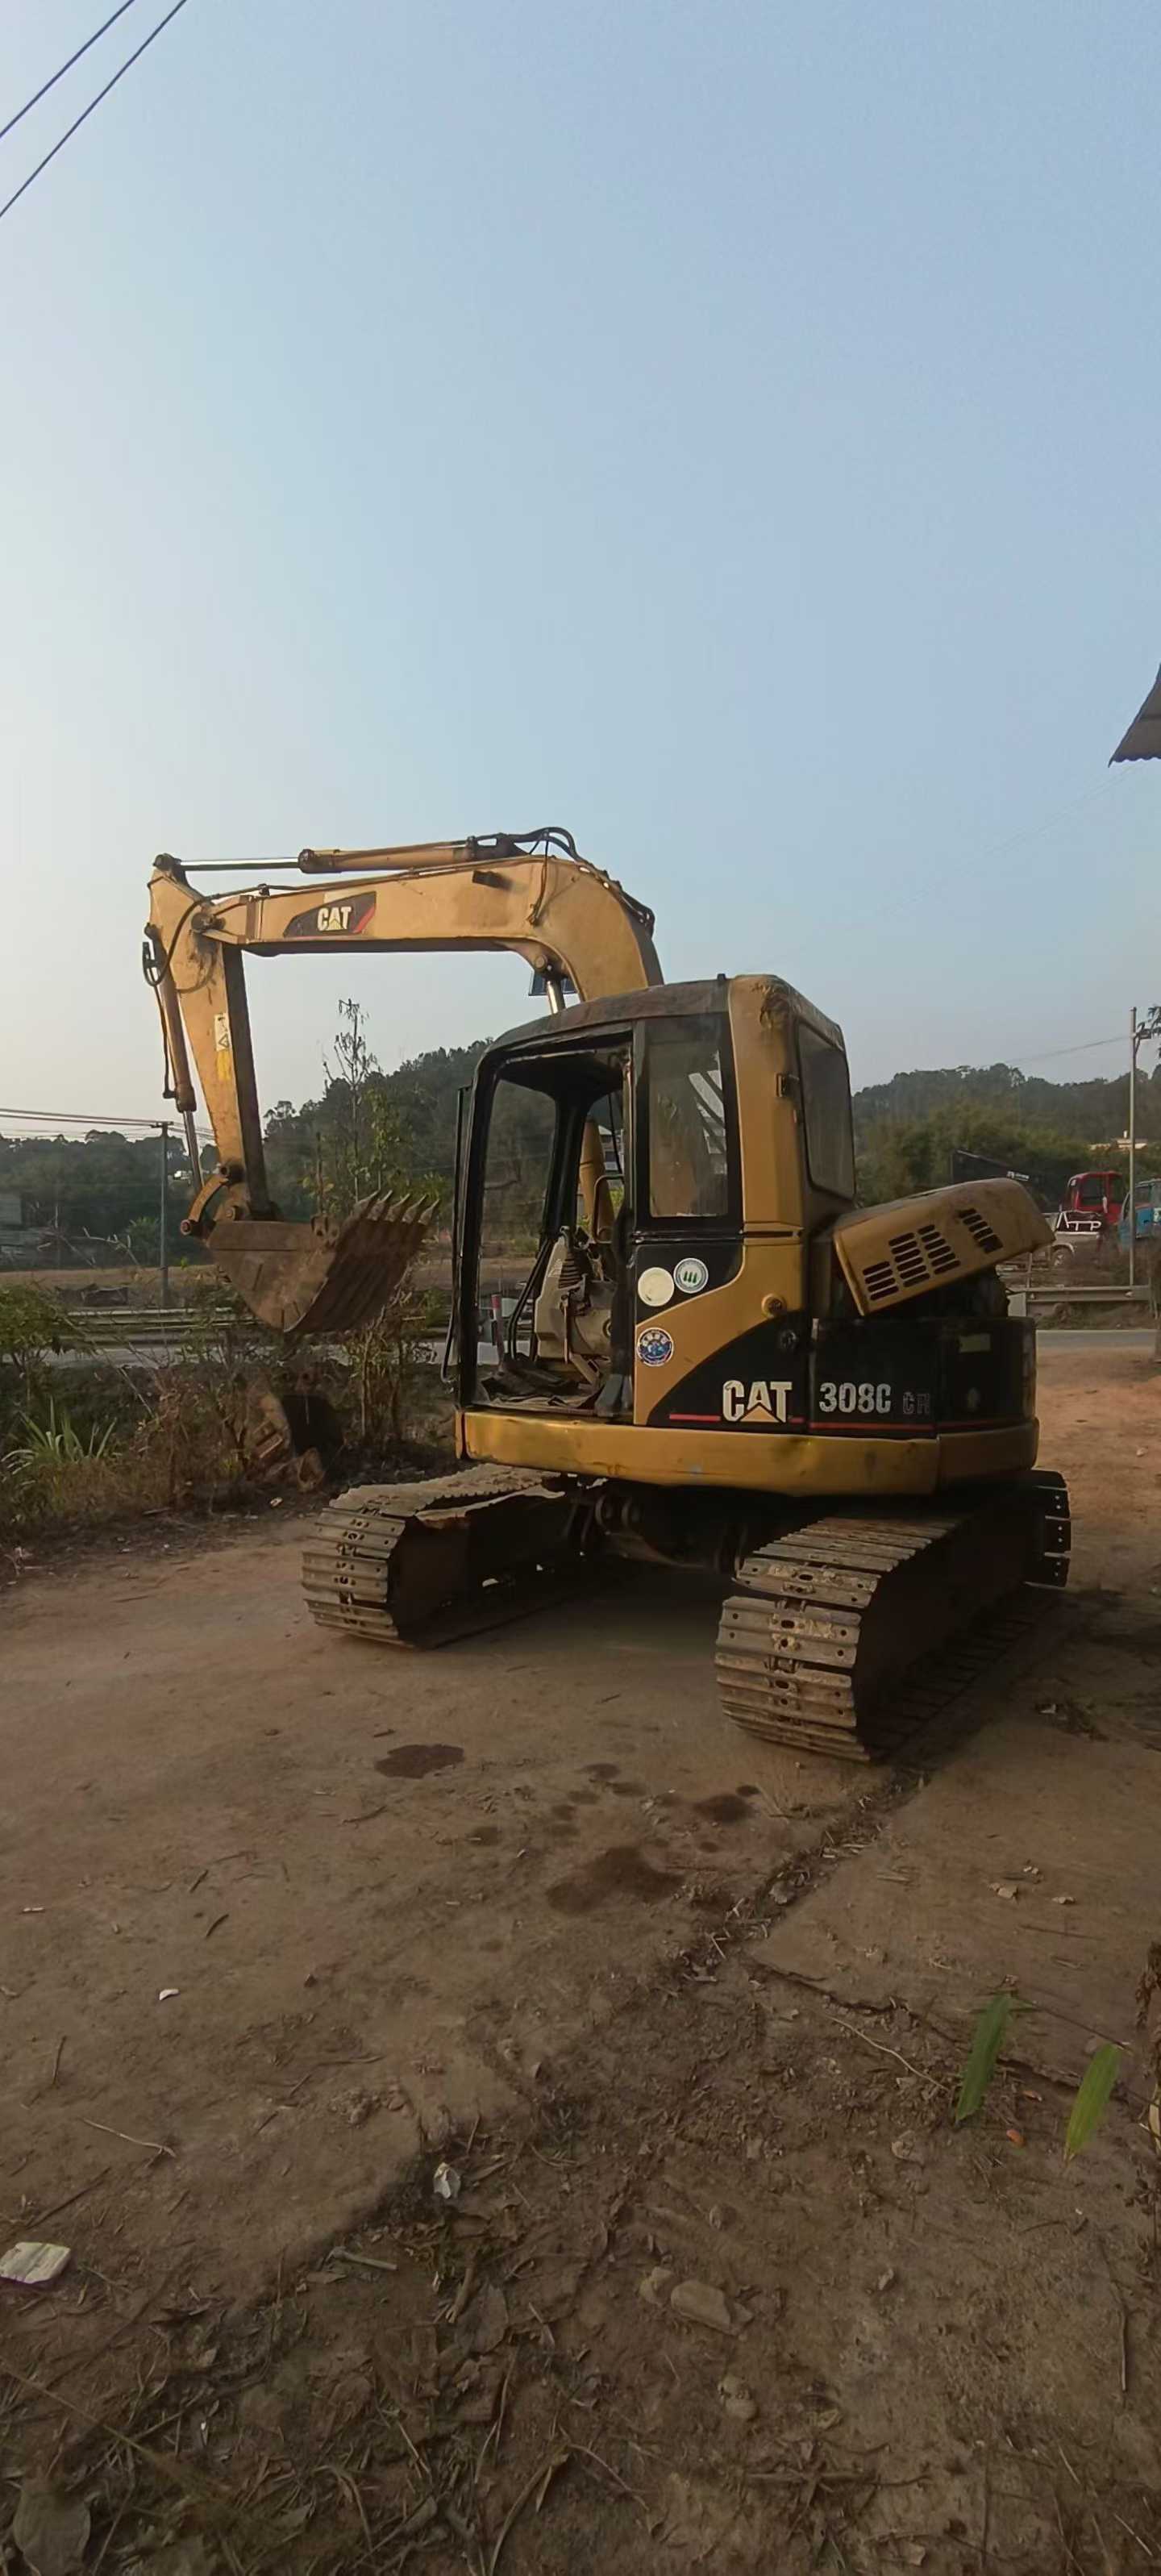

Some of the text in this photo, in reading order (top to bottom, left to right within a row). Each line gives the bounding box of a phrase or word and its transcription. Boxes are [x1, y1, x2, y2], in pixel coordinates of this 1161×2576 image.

[317, 907, 352, 931] CAT
[722, 1380, 793, 1423] CAT
[818, 1382, 891, 1413] 308C
